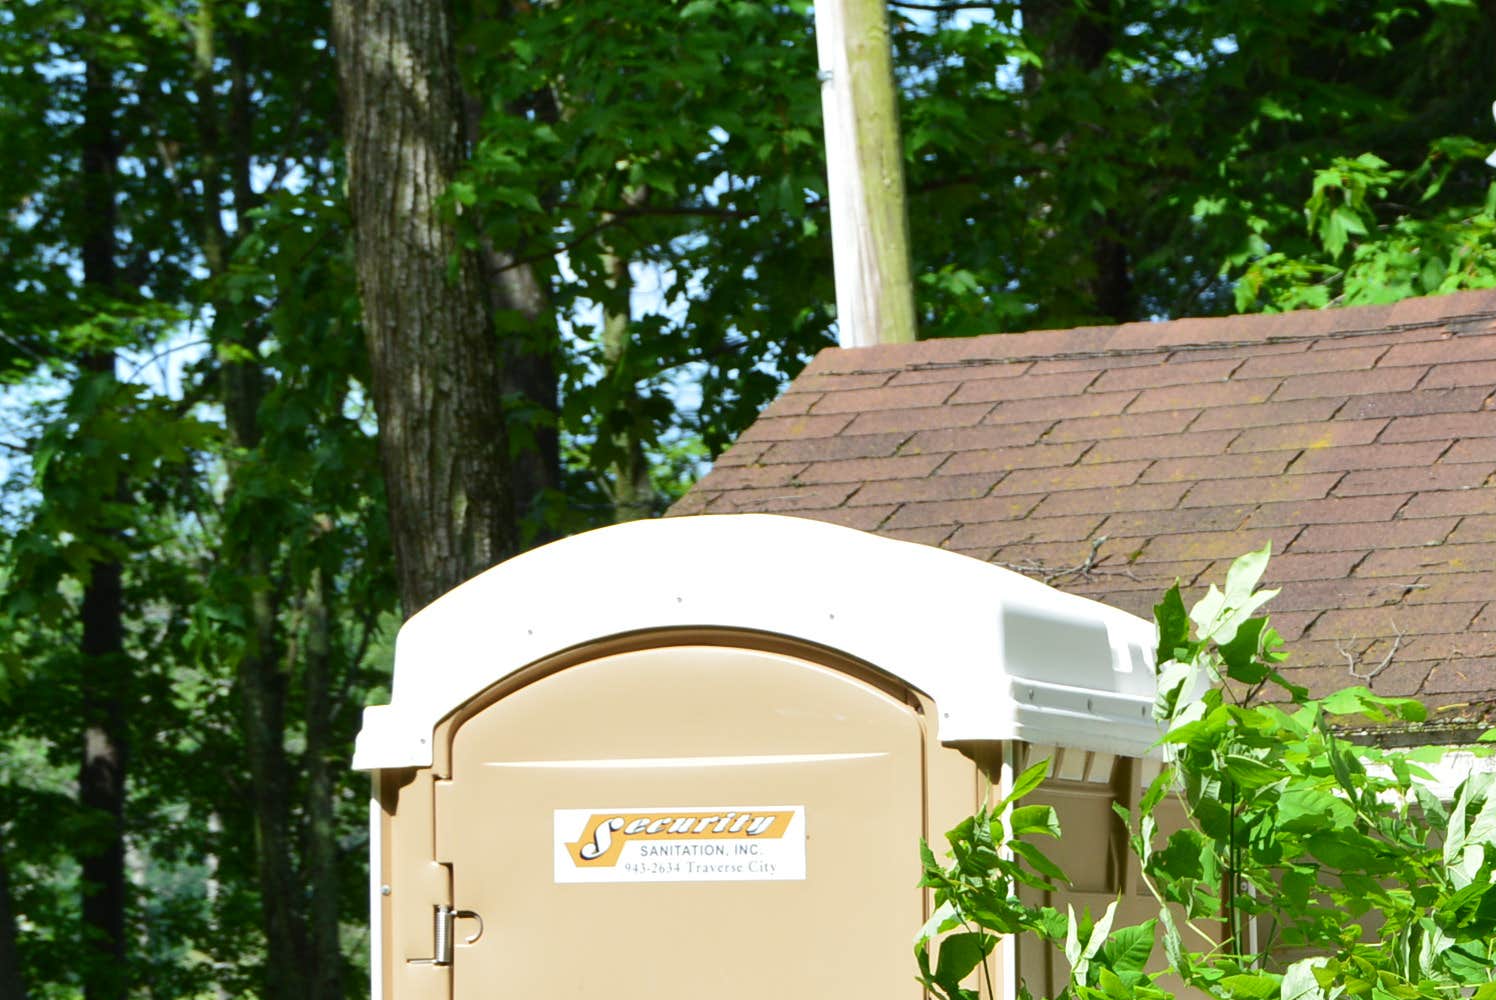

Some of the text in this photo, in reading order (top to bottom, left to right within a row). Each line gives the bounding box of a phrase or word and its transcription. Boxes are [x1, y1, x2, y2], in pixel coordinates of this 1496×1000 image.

[580, 812, 776, 860] Security
[640, 844, 729, 857] SANITATION,
[624, 861, 777, 875] 943-2634 Traverse City
